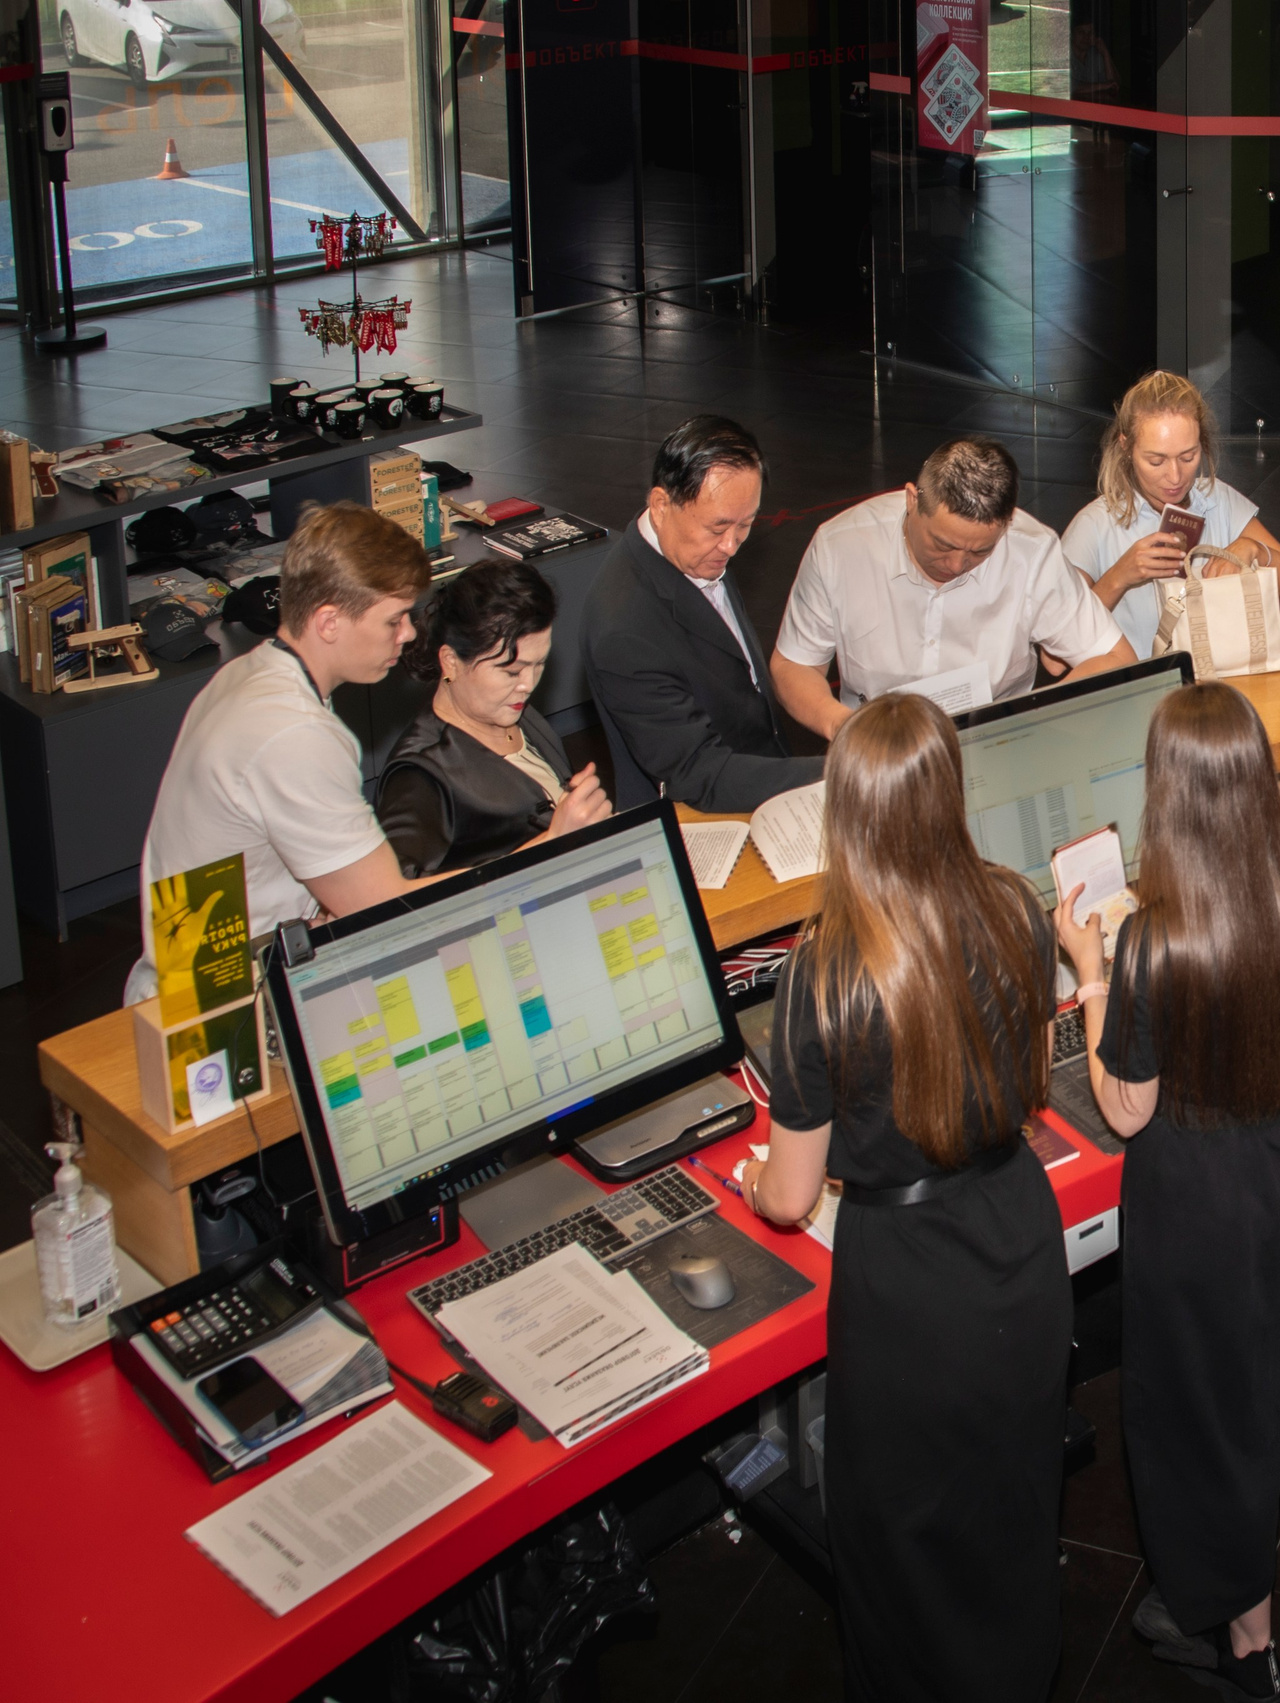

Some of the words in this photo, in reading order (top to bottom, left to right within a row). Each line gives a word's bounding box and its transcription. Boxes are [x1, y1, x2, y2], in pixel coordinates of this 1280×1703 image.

[929, 4, 973, 21] КОЛЛЕКЦИЯ
[539, 42, 619, 66] ОБЪЕКТ
[794, 44, 868, 69] ОБЪЕКТ
[377, 462, 414, 477] FORESTER
[378, 482, 416, 498] FORESTER
[1168, 514, 1198, 529] ПАСПОРТ
[1244, 593, 1267, 655] LIVELINESS
[1190, 616, 1215, 677] LIVELINESS
